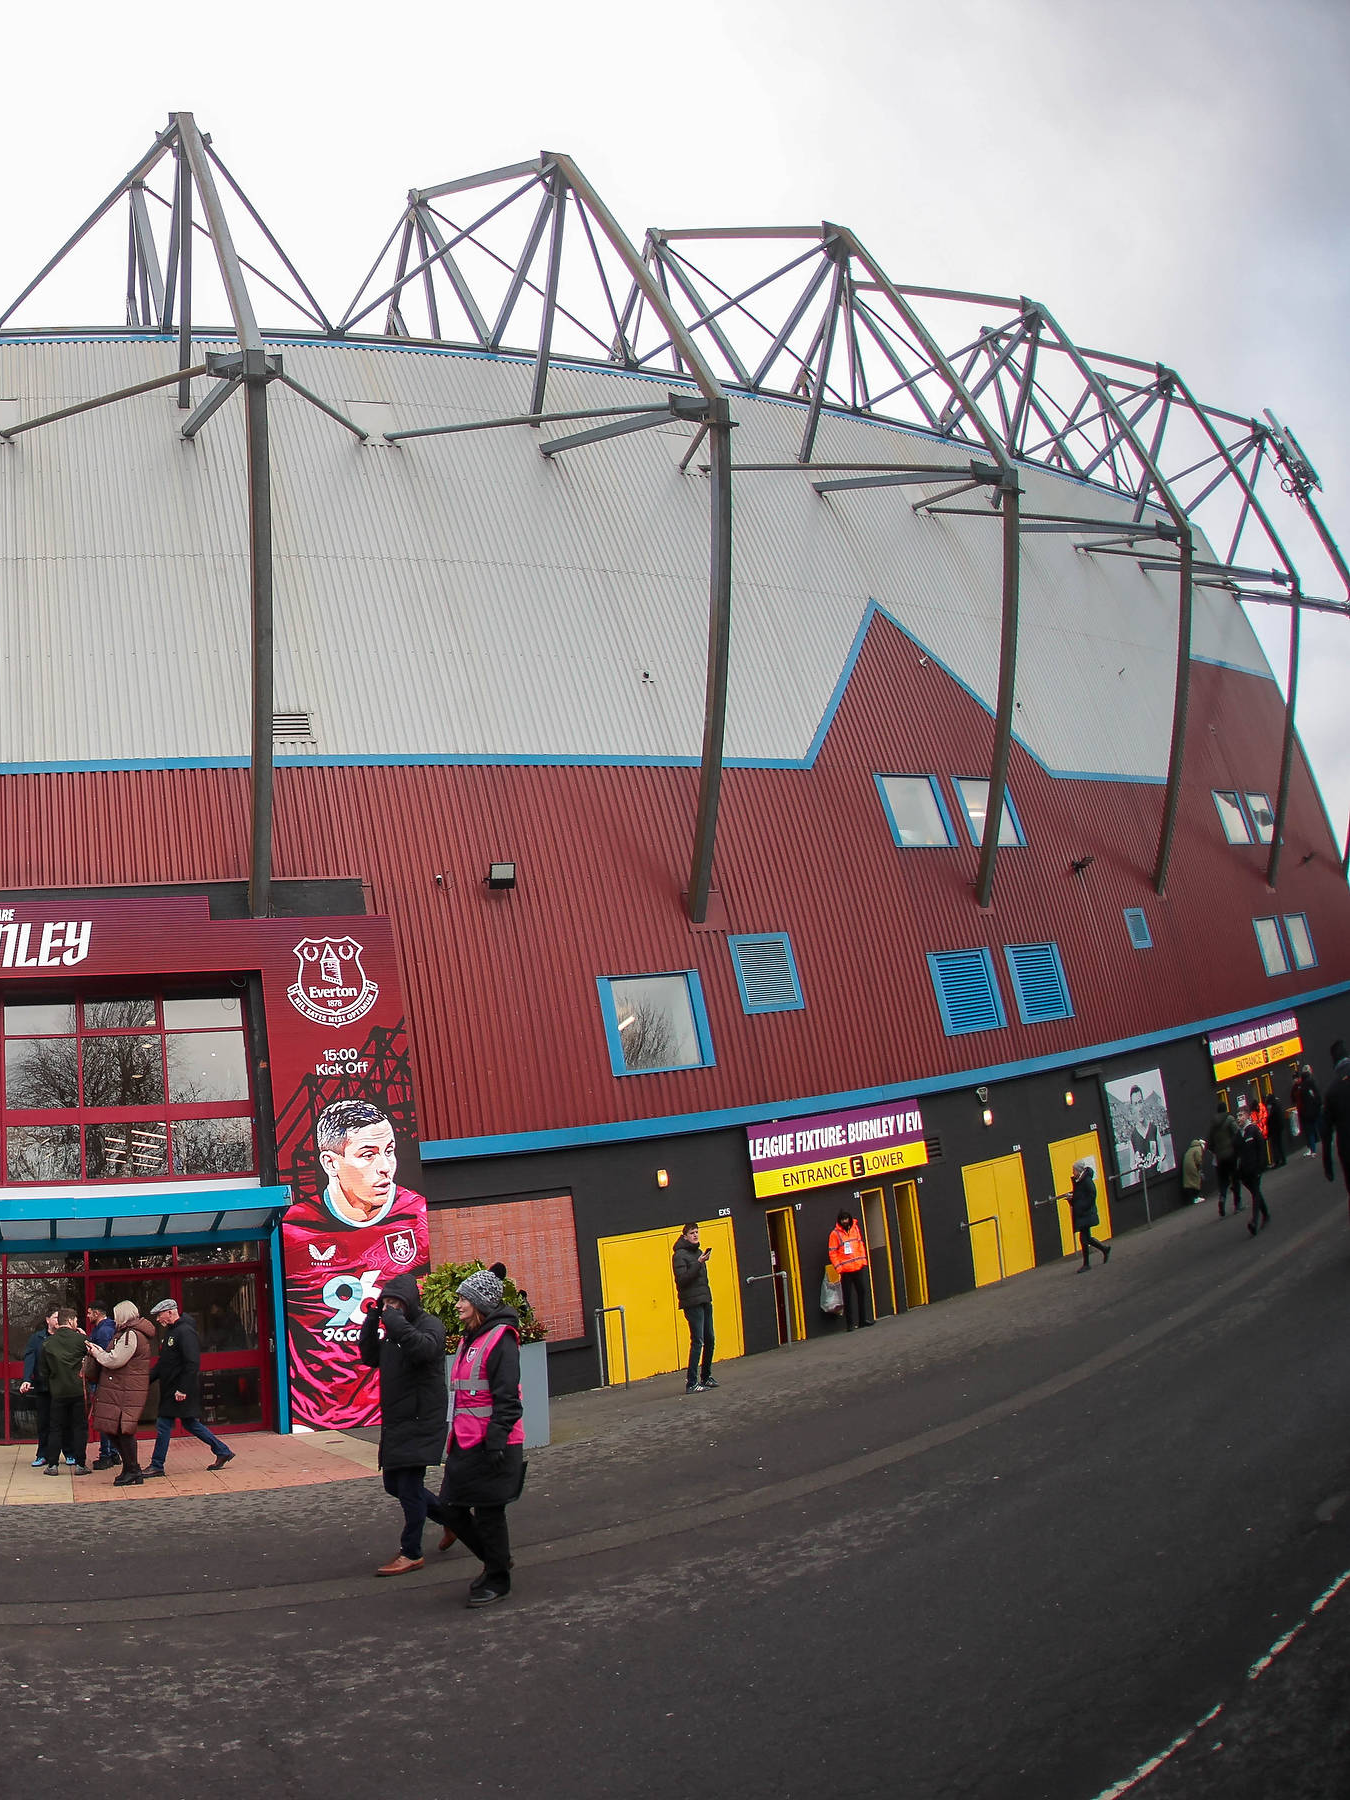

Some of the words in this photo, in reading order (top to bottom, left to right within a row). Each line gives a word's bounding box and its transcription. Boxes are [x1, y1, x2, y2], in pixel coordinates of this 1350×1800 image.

[309, 986, 358, 998] Everton
[294, 997, 305, 1011] NIL
[305, 1008, 326, 1022] SATIS
[346, 994, 374, 1020] OPTIMUM
[316, 1063, 344, 1075] Kick
[346, 1062, 368, 1074] Off
[322, 1048, 358, 1061] 15:00
[749, 1134, 794, 1160] LEAGUE
[796, 1124, 847, 1152] FIXTURE:
[848, 1116, 894, 1144] BURNLEY
[894, 1113, 904, 1134] V
[782, 1162, 848, 1187] ENTRANCE
[866, 1151, 904, 1170] LOWER
[322, 1270, 382, 1326] 96
